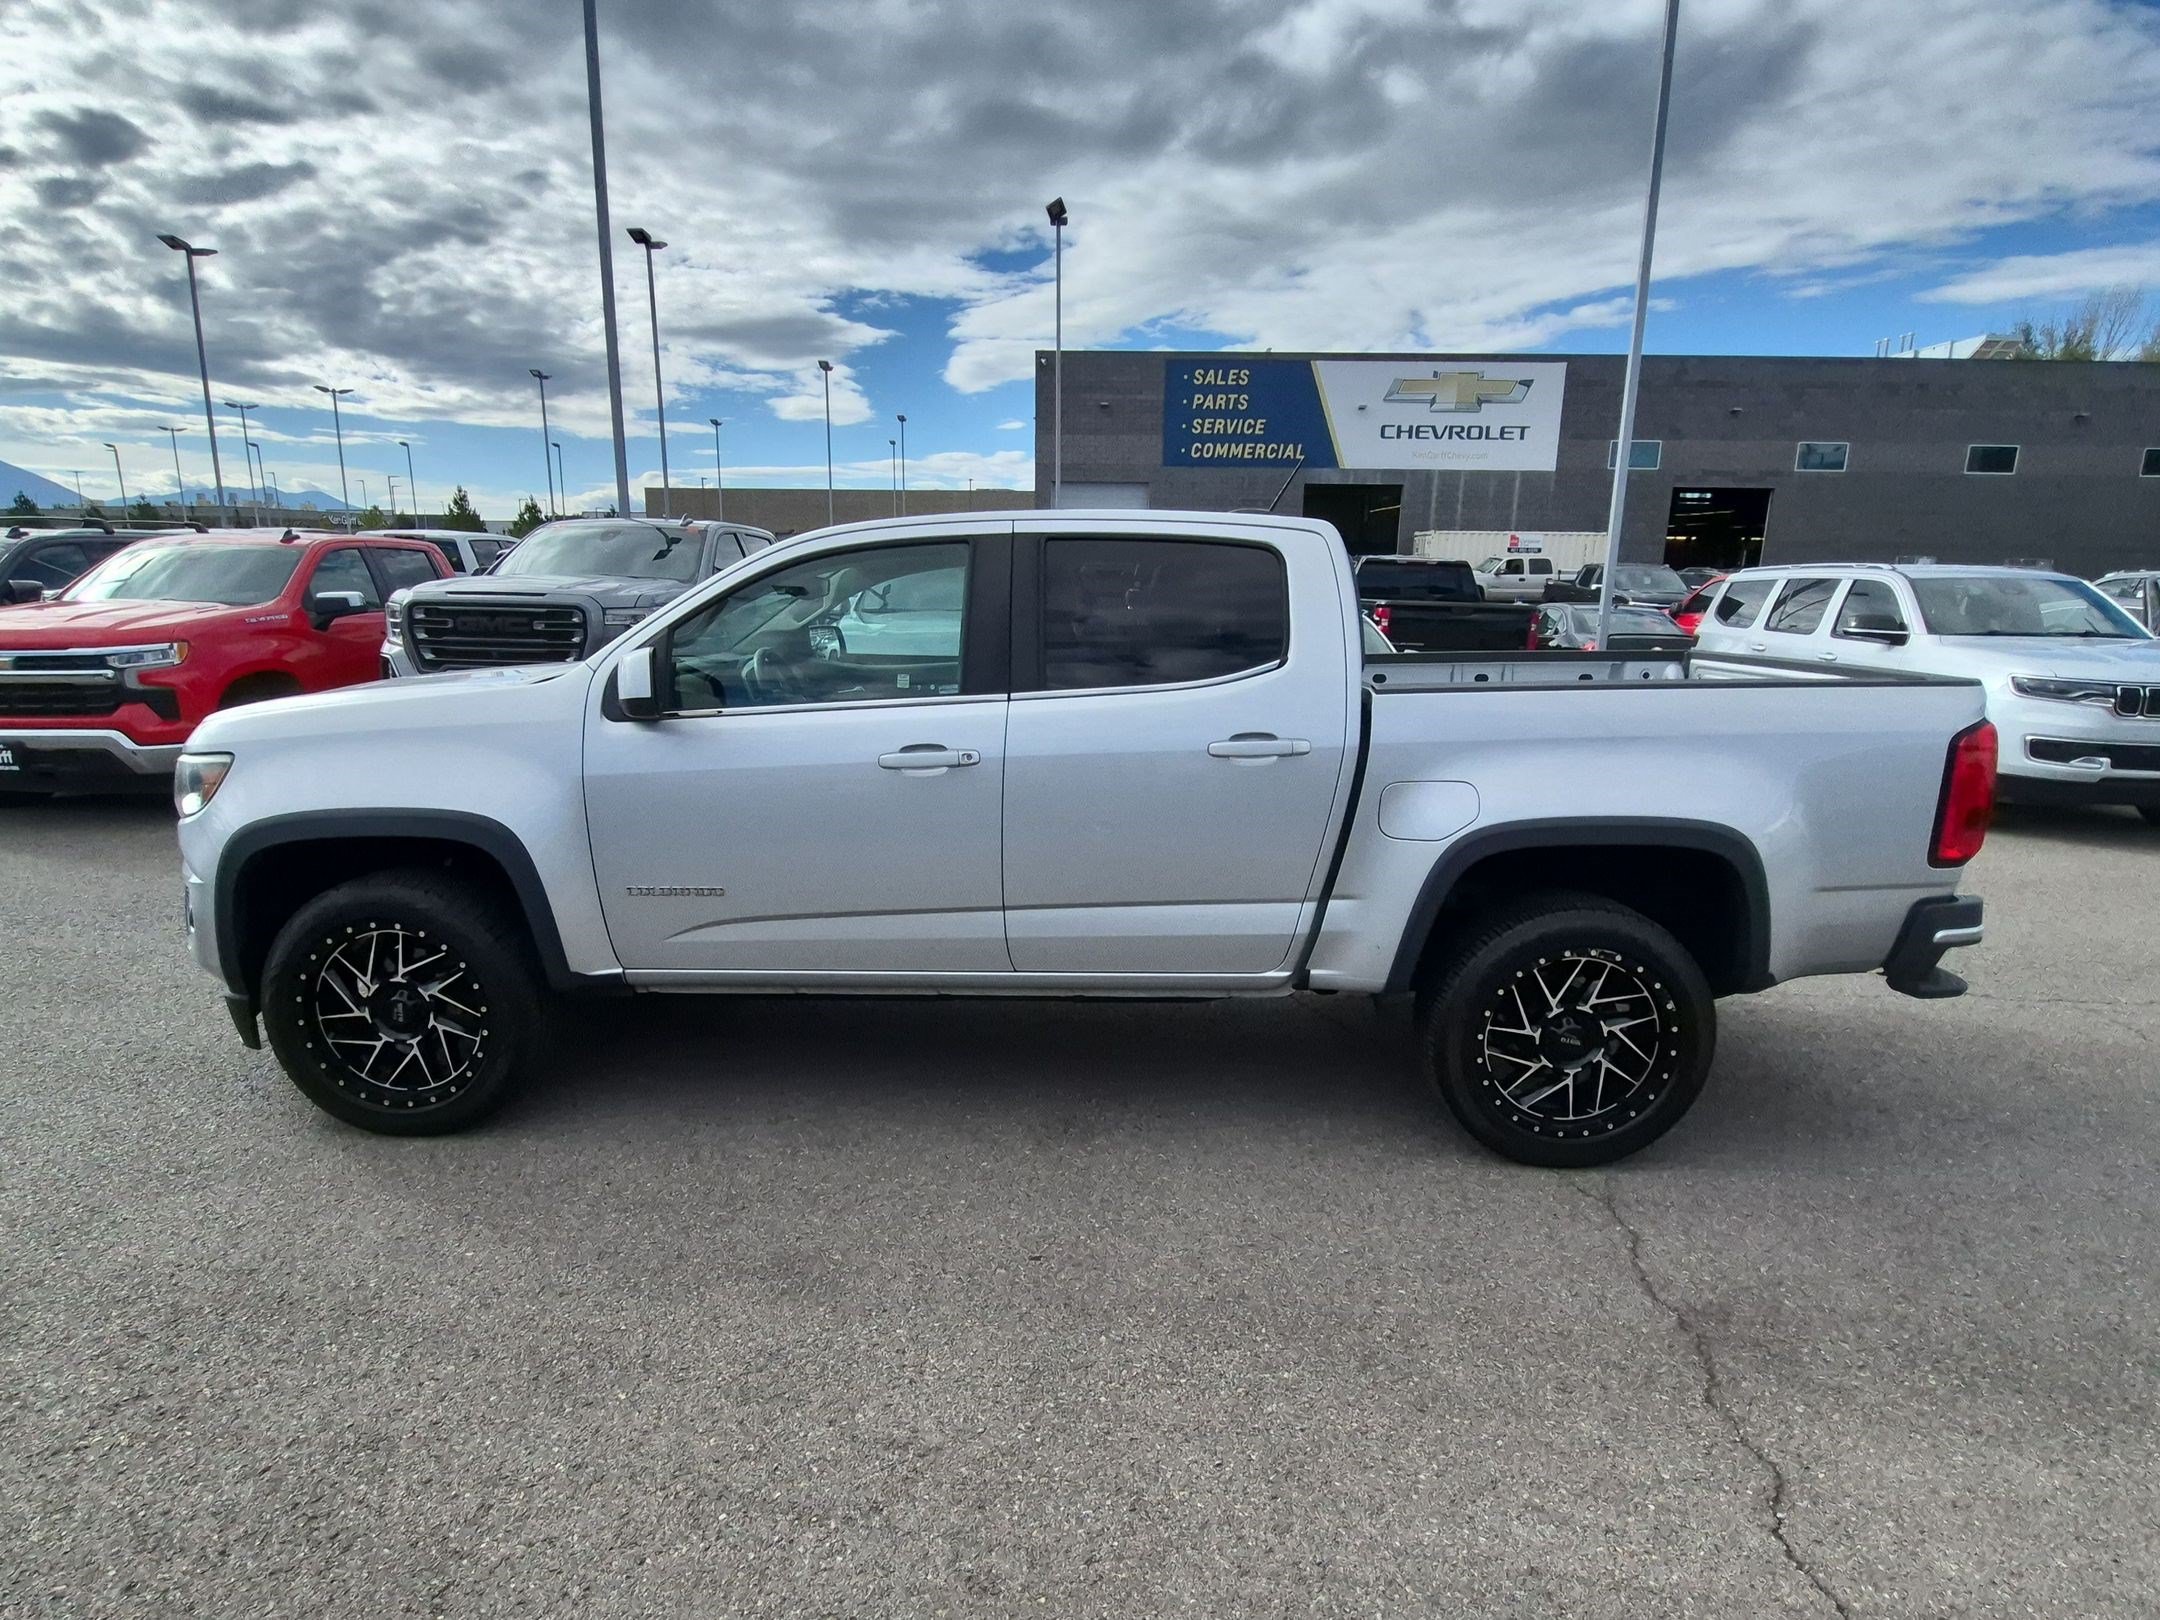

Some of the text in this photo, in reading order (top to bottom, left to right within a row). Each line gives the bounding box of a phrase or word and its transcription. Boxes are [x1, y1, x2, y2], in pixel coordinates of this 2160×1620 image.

[1193, 369, 1250, 386] SALES
[1192, 394, 1249, 410] PARTS
[1191, 419, 1267, 434] SERVICE
[1380, 424, 1531, 441] CHEVROLET
[1190, 442, 1305, 460] COMMERCIAL
